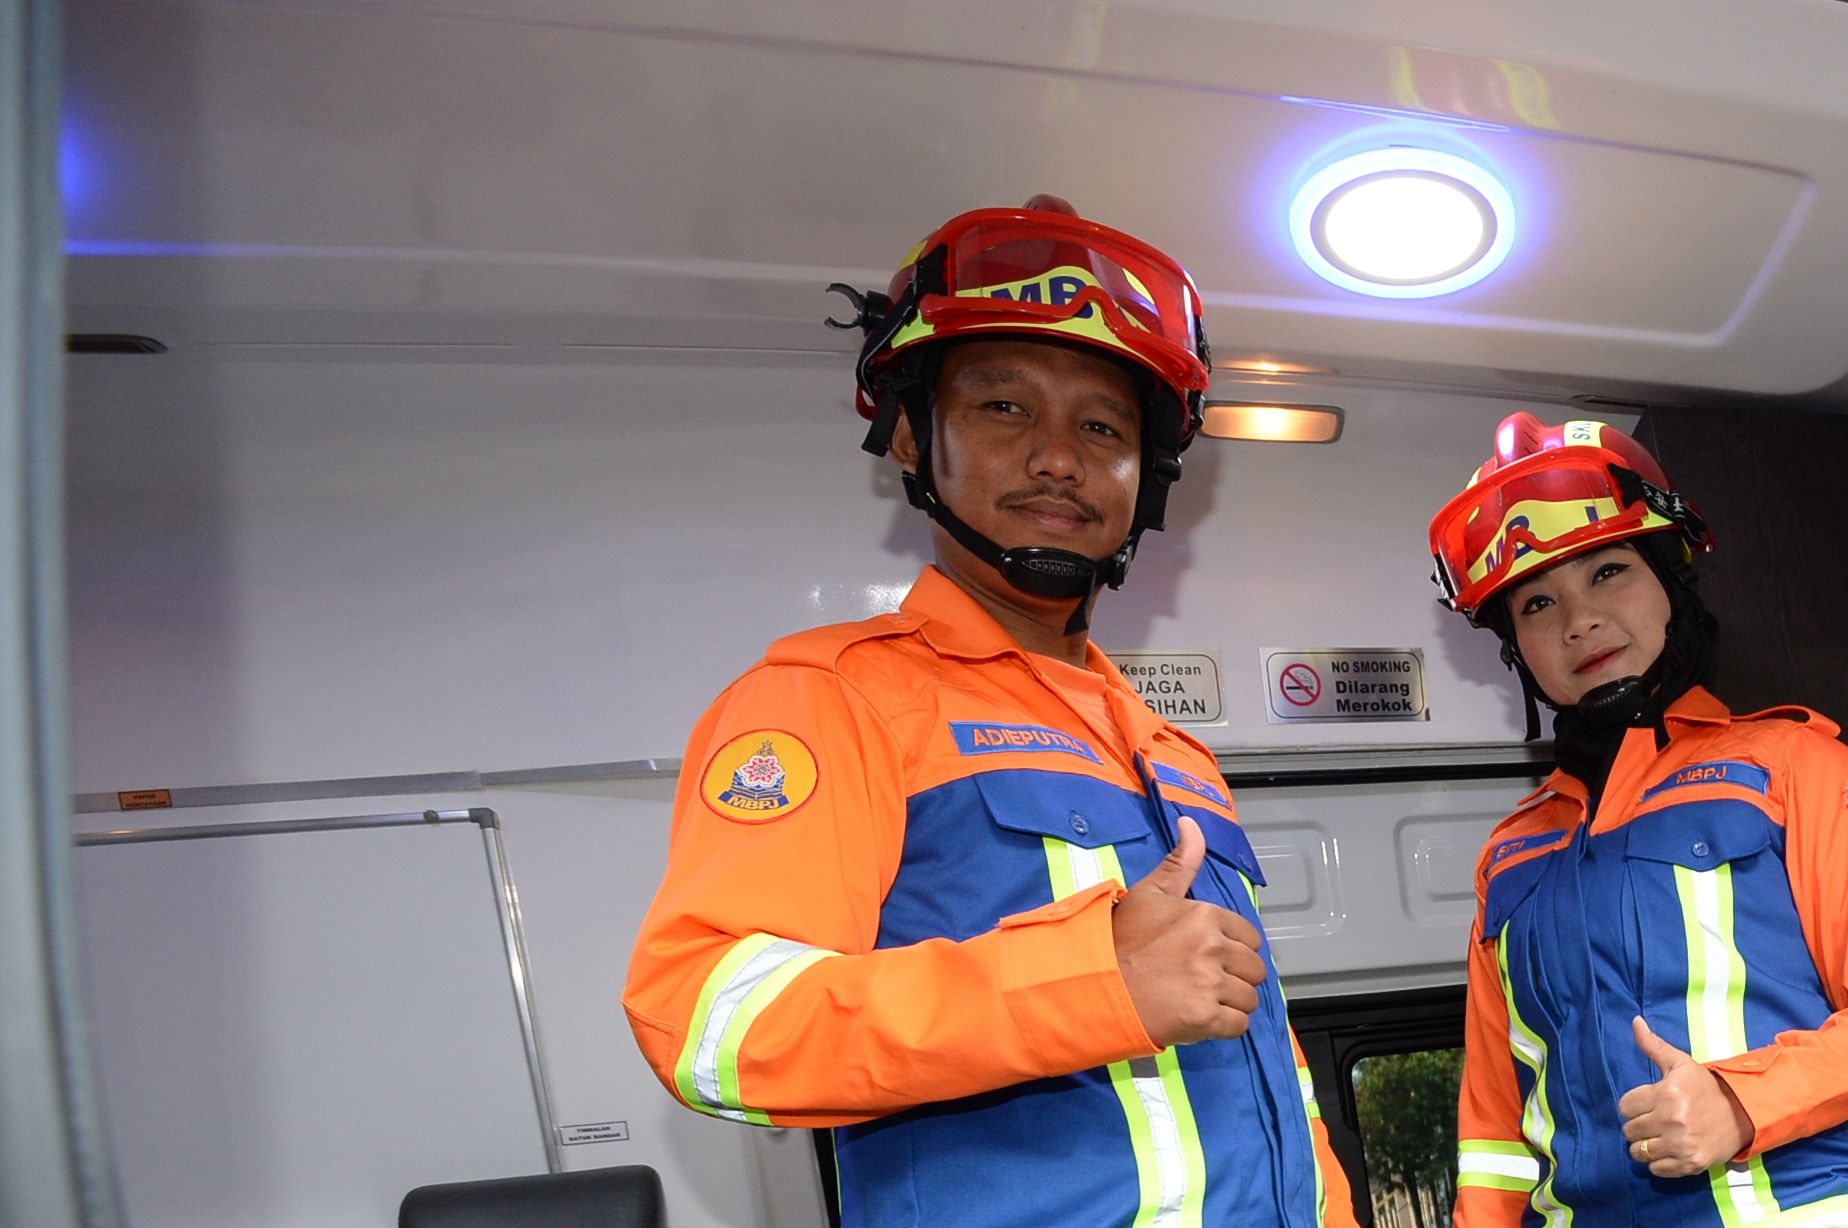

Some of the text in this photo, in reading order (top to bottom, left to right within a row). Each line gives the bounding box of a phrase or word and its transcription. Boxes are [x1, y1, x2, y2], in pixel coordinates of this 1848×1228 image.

[1120, 663, 1201, 678] Keep Clean
[1332, 661, 1410, 673] NO SMOKING
[1134, 680, 1185, 695] JAGA
[1336, 680, 1410, 696] Dilarang
[1145, 698, 1206, 714] SIHAN
[1336, 698, 1413, 713] Merokok
[973, 728, 1088, 755] ADIEPUTRA
[1676, 766, 1727, 784] MBPJ
[728, 795, 780, 810] MBPJ
